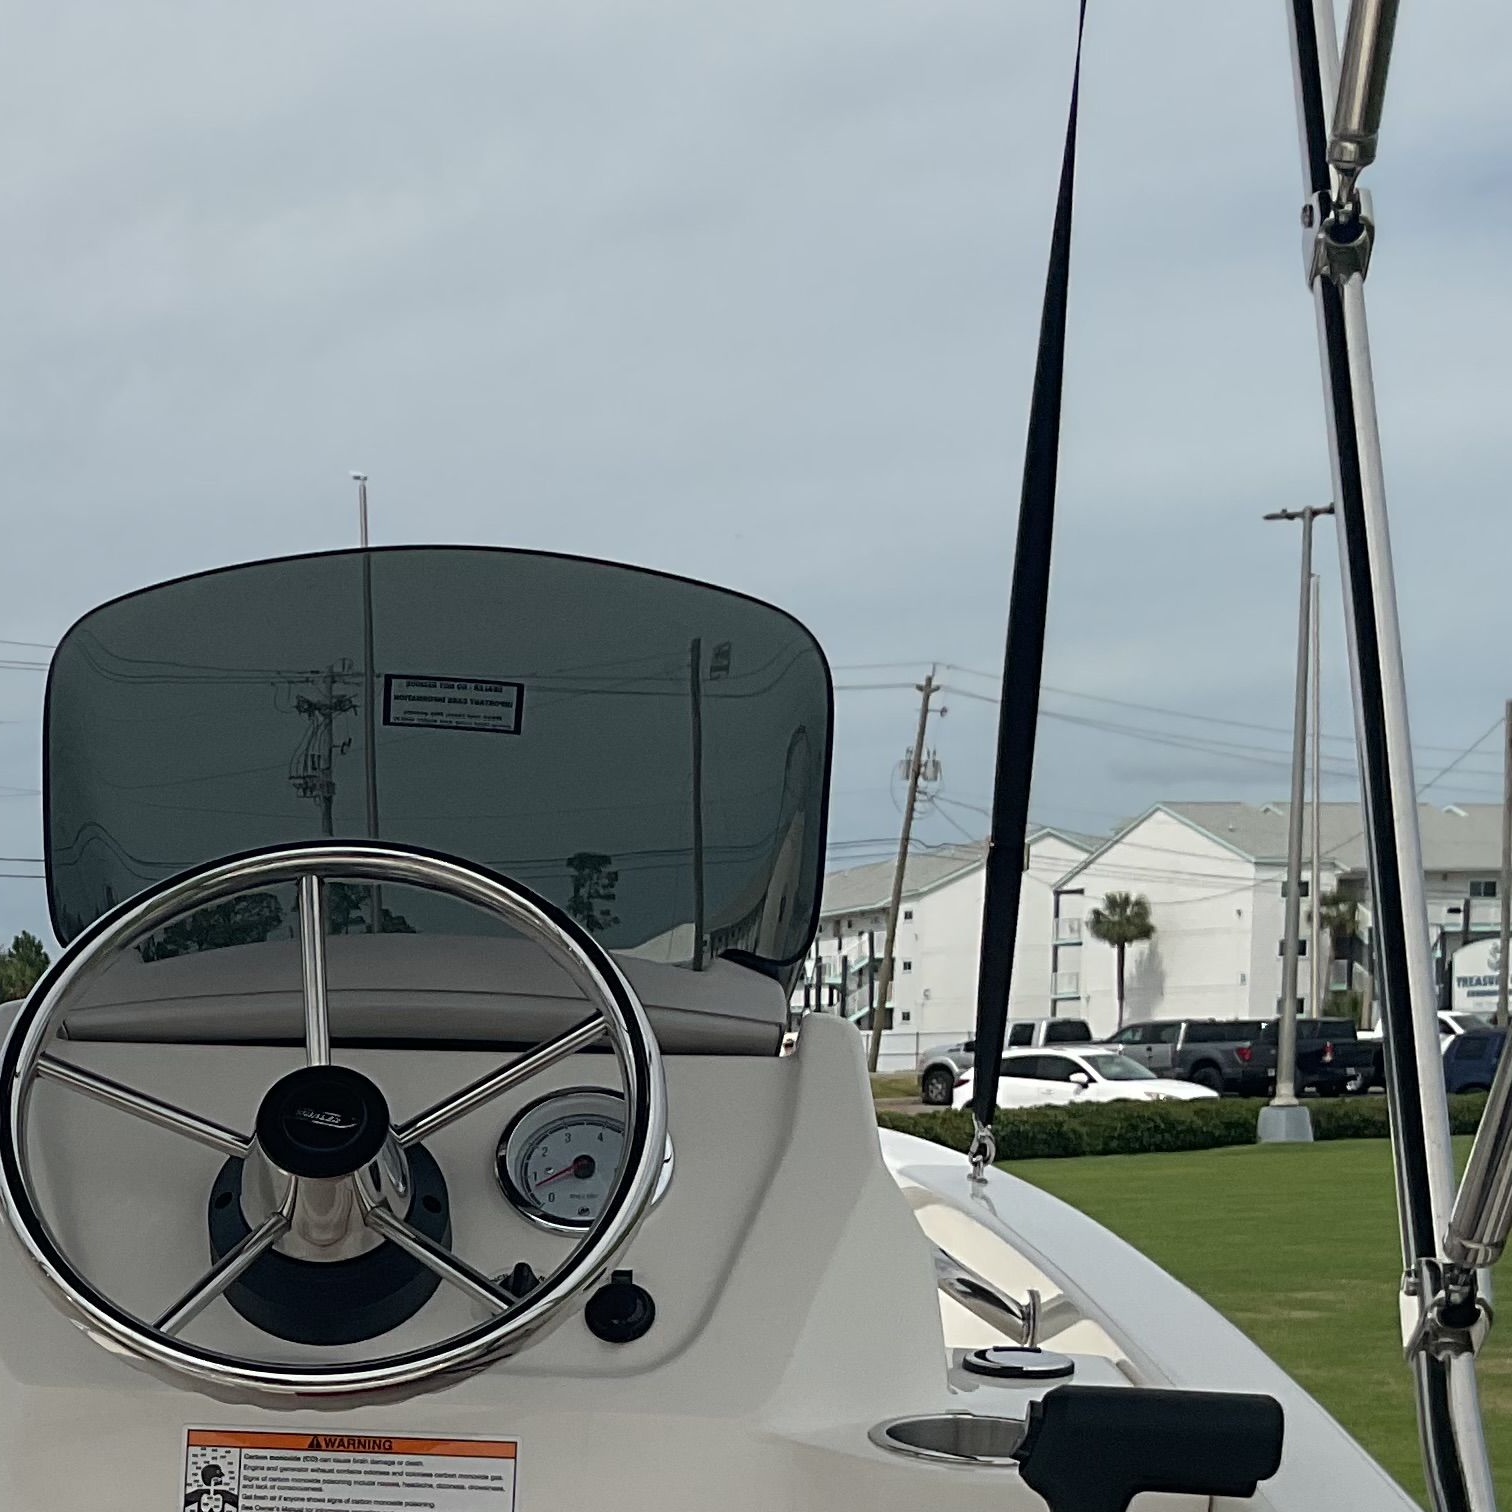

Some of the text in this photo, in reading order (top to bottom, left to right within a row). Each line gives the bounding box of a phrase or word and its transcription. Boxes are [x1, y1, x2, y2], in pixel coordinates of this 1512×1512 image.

[564, 1132, 572, 1144] 3
[597, 1132, 604, 1142] 4
[541, 1147, 549, 1157] 2
[533, 1171, 538, 1181] 1
[548, 1192, 555, 1203] 0
[323, 1437, 393, 1450] WARNING
[243, 1463, 265, 1472] Engine
[254, 1504, 280, 1512] Owner's
